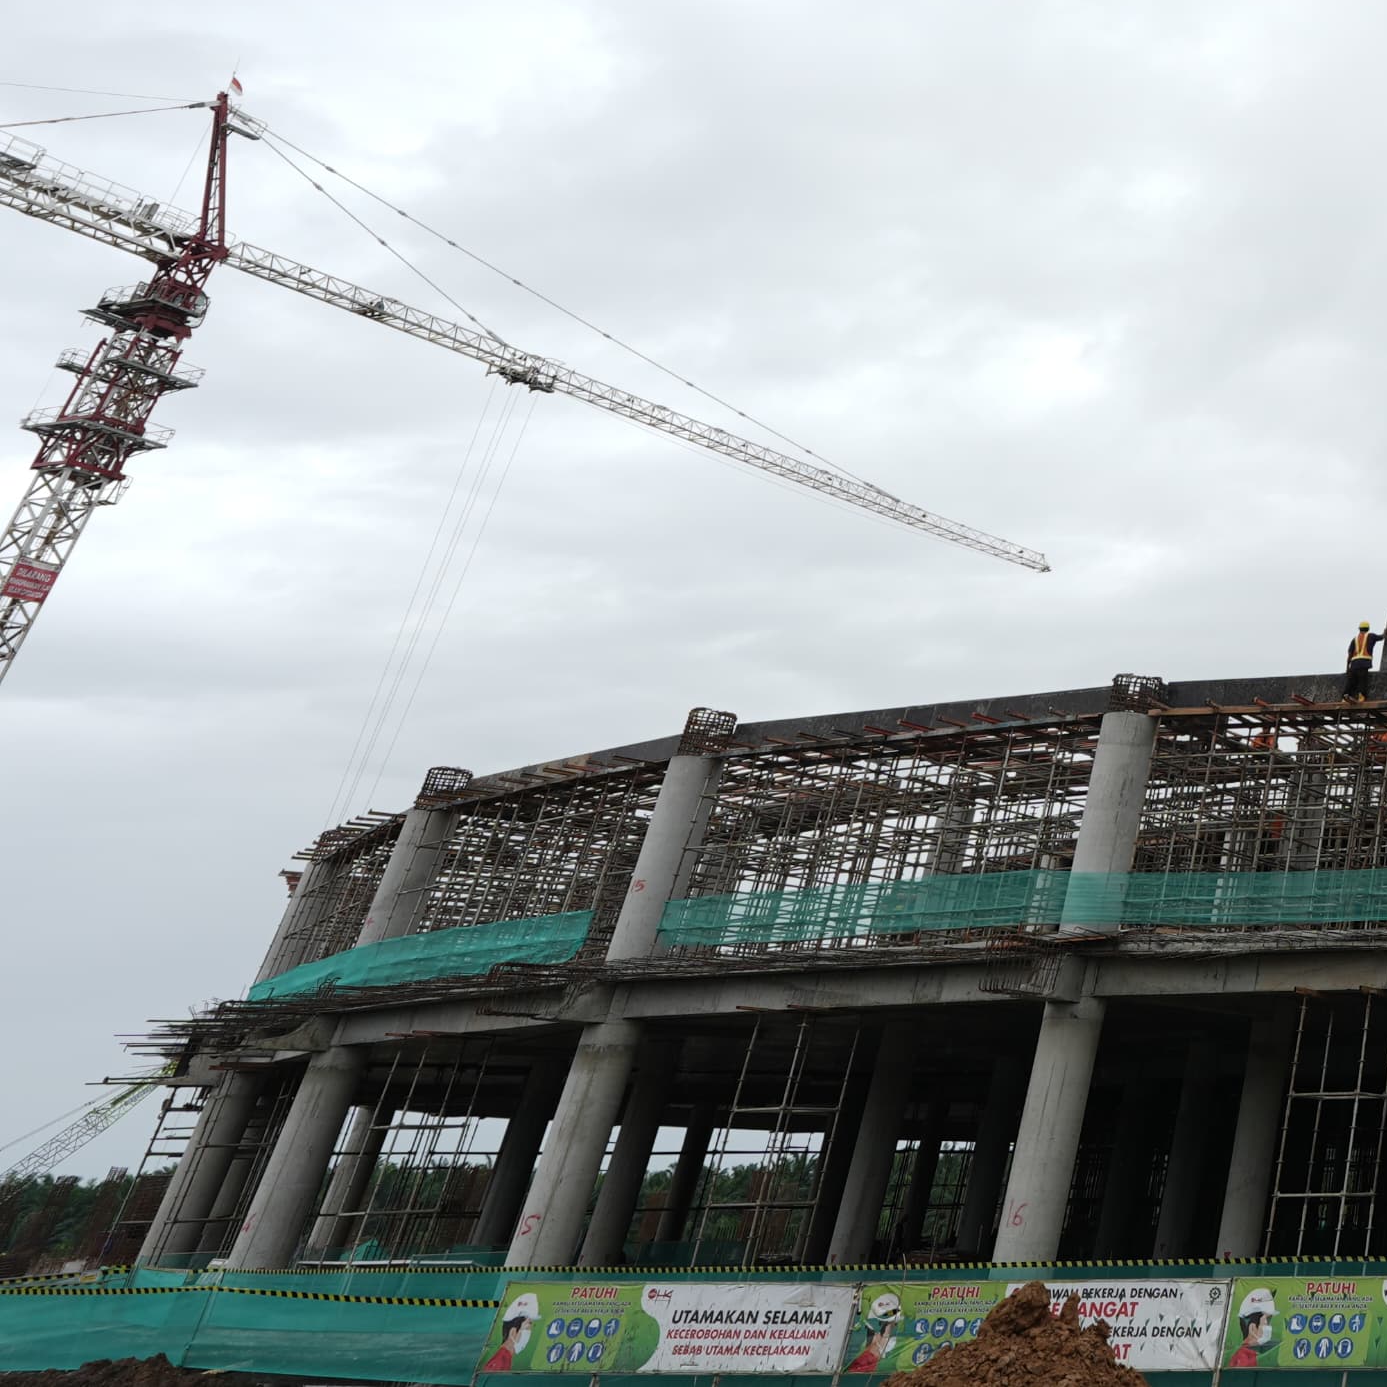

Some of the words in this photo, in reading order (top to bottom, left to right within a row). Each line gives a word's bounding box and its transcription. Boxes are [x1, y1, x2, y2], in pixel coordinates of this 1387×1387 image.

[1006, 1198, 1030, 1227] 16
[571, 1287, 618, 1299] PATUHI
[932, 1286, 980, 1298] PATUHI
[1082, 1288, 1126, 1299] BEKERJA
[1130, 1288, 1178, 1299] DENGAN
[1307, 1282, 1355, 1294] PATUHI
[672, 1310, 759, 1324] UTAMAKAN
[763, 1310, 832, 1324] SELAMAT
[666, 1329, 741, 1340] KECEROBOHAN
[744, 1329, 767, 1339] DAN
[769, 1330, 826, 1339] KELALAIAN
[1151, 1326, 1202, 1338] DENGAN
[672, 1345, 702, 1355] SEBAB
[705, 1346, 740, 1355] UTAMA
[743, 1346, 810, 1356] KECELAKAAN
